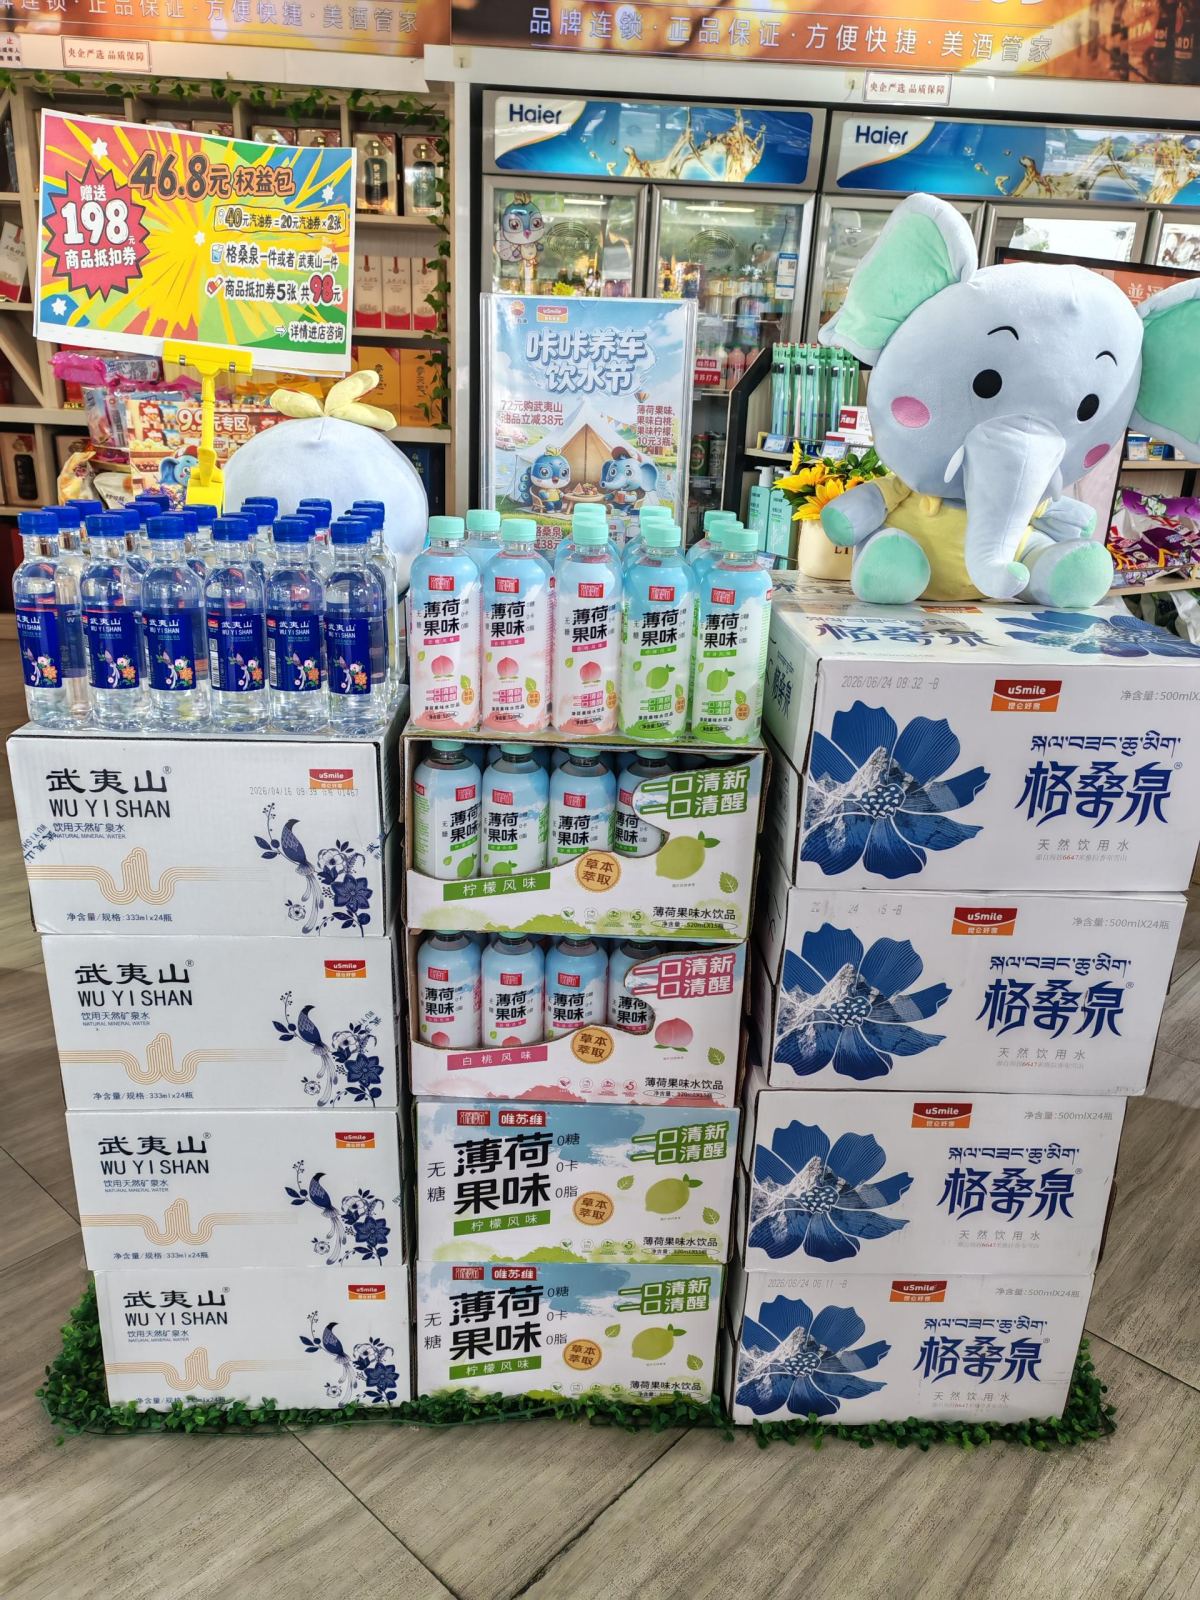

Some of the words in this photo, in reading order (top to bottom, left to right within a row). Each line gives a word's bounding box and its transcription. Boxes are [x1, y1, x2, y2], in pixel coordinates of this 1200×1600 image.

[869, 82, 906, 94] 央企严选
[908, 84, 945, 97] 品质保障
[509, 104, 562, 124] Haier
[855, 124, 908, 145] Haier
[80, 184, 107, 201] 赠送
[65, 247, 138, 269] 商品抵扣券
[224, 278, 297, 301] 商品抵扣券5张
[300, 274, 342, 304] 共98元
[288, 324, 344, 343] 详情进店咨询
[525, 327, 648, 366] 咔咔养车
[545, 360, 635, 396] 饮水节
[500, 400, 563, 413] 72元购武夷山
[500, 412, 564, 426] 油品立减38元
[423, 598, 461, 619] 薄荷
[490, 600, 526, 620] 薄荷
[572, 604, 609, 626] 薄荷
[221, 620, 252, 630] 武夷山
[279, 620, 310, 629] 武夷山
[641, 608, 680, 629] 薄荷
[704, 612, 740, 631] 薄荷
[423, 617, 460, 637] 果味
[490, 619, 525, 638] 果味
[572, 623, 608, 643] 果味
[640, 627, 678, 647] 果味
[704, 630, 738, 649] 果味
[1007, 685, 1047, 695] uSmile
[1120, 690, 1200, 701] 净含量:500mlX
[45, 767, 168, 795] 武夷山
[644, 769, 748, 795] 一口清新
[1014, 760, 1173, 829] 格桑泉
[116, 799, 171, 818] SHAN
[642, 791, 745, 817] 一口清醒
[450, 805, 482, 828] 薄荷
[488, 812, 518, 828] 薄荷
[558, 814, 592, 831] 薄荷
[52, 822, 126, 833] 饮用天然矿泉水
[449, 821, 481, 844] 果味
[487, 828, 518, 844] 果味
[557, 830, 591, 846] 果味
[614, 830, 639, 845] 果味
[1037, 838, 1129, 852] 天然饮用水
[584, 857, 614, 874] 草本
[582, 871, 611, 886] 萃取
[462, 877, 537, 897] 柠檬风味
[652, 906, 736, 921] 薄荷果味水饮品
[966, 912, 1003, 921] uSmile
[74, 962, 190, 986] 武夷山
[634, 956, 734, 978] 一口清新
[425, 987, 455, 1001] 薄荷
[633, 976, 731, 998] 一口清醒
[141, 989, 193, 1007] SHAN
[495, 991, 527, 1007] 薄荷
[553, 992, 586, 1007] 薄荷
[618, 995, 647, 1011] 薄荷
[80, 1011, 150, 1021] 饮用天然矿泉水
[425, 1002, 454, 1016] 果味
[495, 1005, 527, 1021] 果味
[553, 1007, 585, 1021] 果味
[617, 1010, 647, 1024] 果味
[975, 978, 1125, 1040] 格桑泉
[580, 1033, 608, 1047] 草本
[462, 1053, 532, 1067] 白桃风味
[577, 1045, 605, 1059] 萃取
[997, 1047, 1086, 1060] 天然饮用水
[645, 1076, 724, 1090] 薄荷果味水饮品
[501, 1113, 543, 1125] 唯苏维
[925, 1107, 960, 1115] uSmile
[556, 1132, 580, 1147] 0糖
[633, 1123, 727, 1145] 一口清新
[97, 1135, 207, 1156] 武夷山
[633, 1142, 725, 1163] 一口清醒
[453, 1131, 554, 1178] 薄荷
[160, 1159, 210, 1174] SHAN
[556, 1159, 578, 1172] 0卡
[103, 1179, 169, 1188] 饮用天然矿泉水
[453, 1172, 551, 1215] 果味
[555, 1185, 578, 1199] 0脂
[935, 1167, 1075, 1223] 格桑泉
[580, 1197, 608, 1210] 草本
[578, 1207, 606, 1221] 萃取
[471, 1214, 538, 1232] 柠檬风味
[643, 1236, 718, 1247] 薄荷果味水饮品
[958, 1229, 1040, 1241] 天然饮用水
[494, 1269, 534, 1280] 唯苏维
[547, 1286, 569, 1298] 0糖
[620, 1279, 708, 1297] 一口清新
[123, 1289, 226, 1309] 武夷山
[449, 1284, 544, 1327] 薄荷
[619, 1296, 707, 1313] 一口清醒
[181, 1311, 228, 1326] SHAN
[546, 1310, 568, 1322] 0卡
[127, 1329, 189, 1338] 饮用天然矿泉水
[449, 1321, 542, 1361] 果味
[545, 1333, 568, 1345] 0脂
[571, 1344, 596, 1356] 草本
[465, 1360, 529, 1376] 柠檬风味
[568, 1354, 594, 1366] 萃取
[912, 1336, 1043, 1385] 格桑泉
[629, 1380, 702, 1391] 薄荷果味水饮品
[933, 1391, 1011, 1402] 天然饮用水
